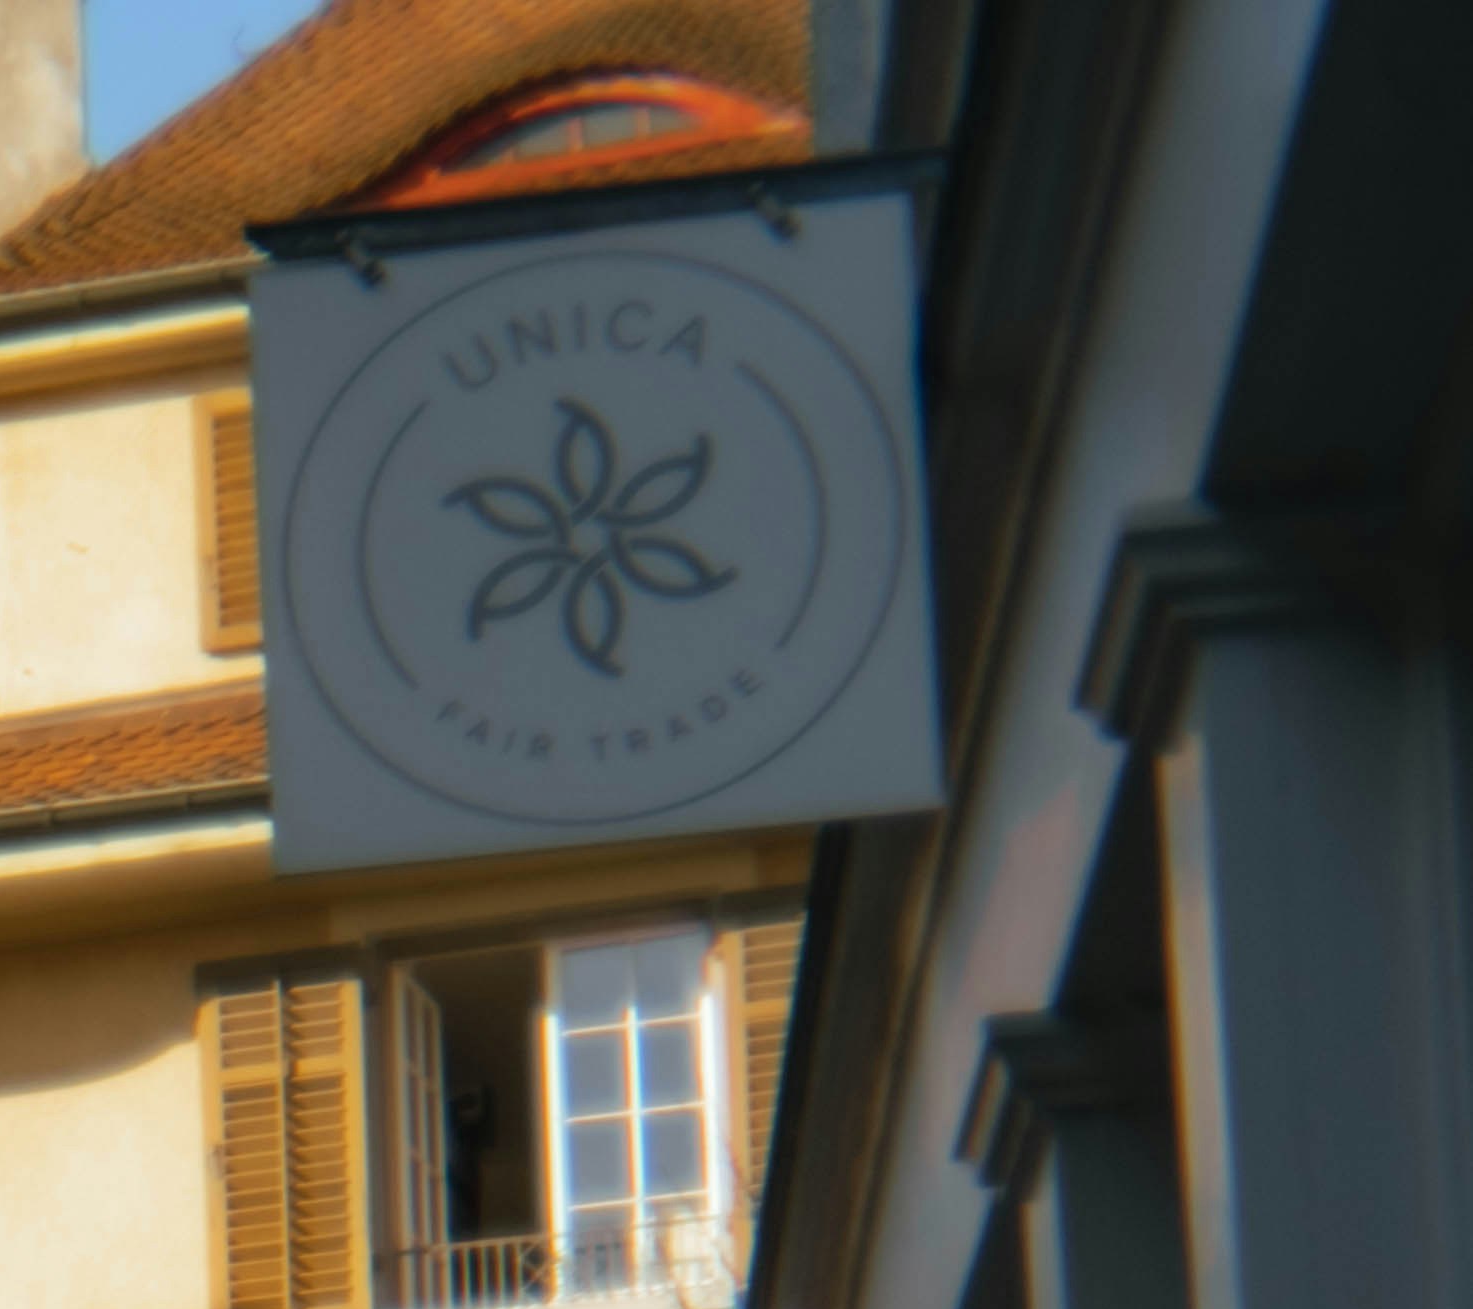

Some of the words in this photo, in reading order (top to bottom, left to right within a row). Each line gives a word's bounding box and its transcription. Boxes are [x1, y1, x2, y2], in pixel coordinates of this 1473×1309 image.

[443, 298, 709, 393] UNICA
[435, 699, 554, 760] FAIR
[590, 668, 764, 763] TRADE
